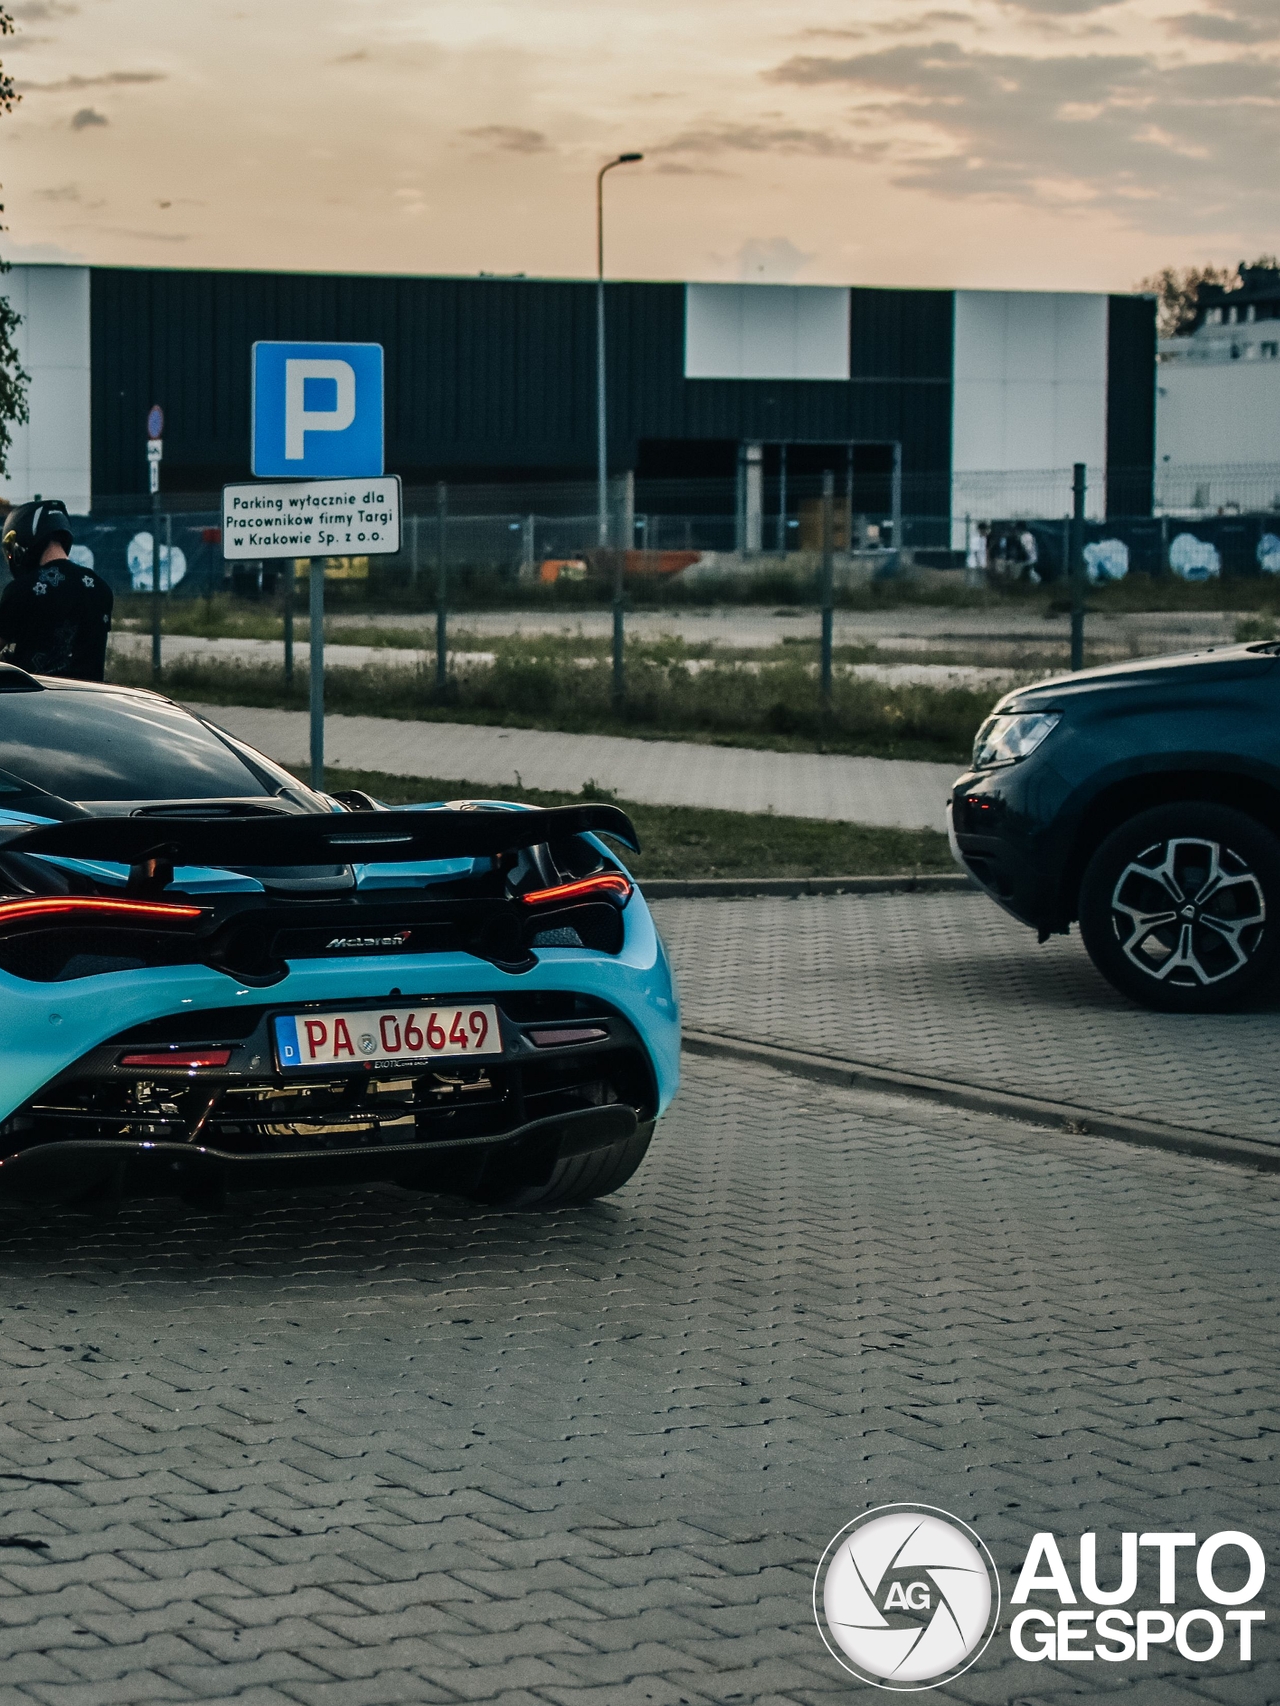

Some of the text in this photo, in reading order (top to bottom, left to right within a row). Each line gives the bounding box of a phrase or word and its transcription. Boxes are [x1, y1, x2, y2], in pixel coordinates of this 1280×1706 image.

[285, 359, 355, 460] P
[233, 491, 385, 511] Parking wyłącznie dla
[226, 509, 393, 528] Pracowników firmy Targi
[234, 531, 384, 546] w Krakowie Sp. z o.o.
[325, 937, 403, 948] McLaren
[304, 1010, 489, 1058] PA 06649
[284, 1046, 294, 1058] D
[374, 1060, 401, 1069] EXOTIC
